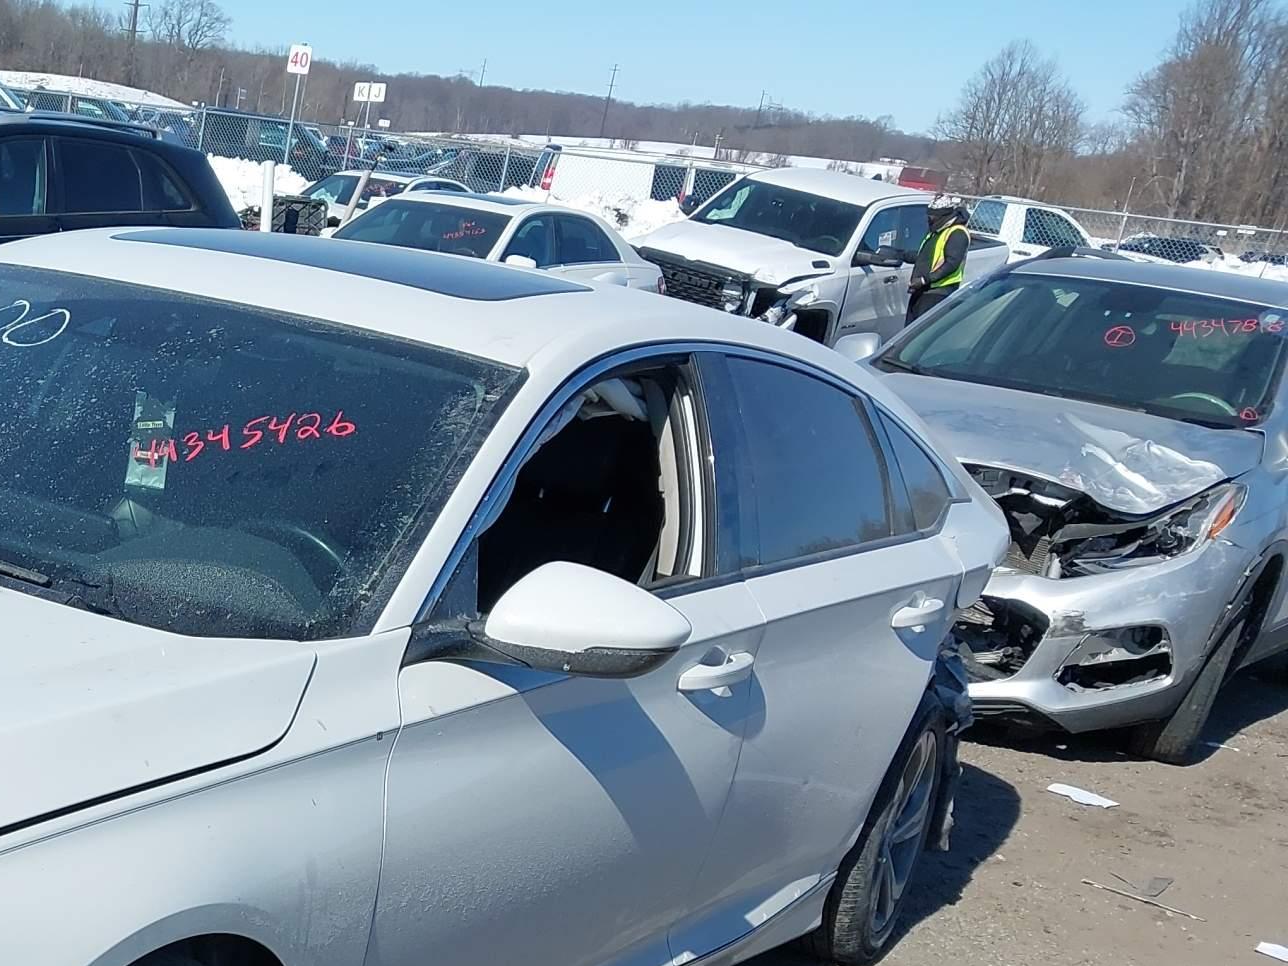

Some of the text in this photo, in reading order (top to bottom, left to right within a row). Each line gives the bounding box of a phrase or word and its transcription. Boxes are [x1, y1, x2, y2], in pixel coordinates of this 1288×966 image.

[290, 51, 309, 68] 40
[357, 86, 366, 98] K
[373, 87, 382, 98] J
[133, 411, 356, 468] 44345426
